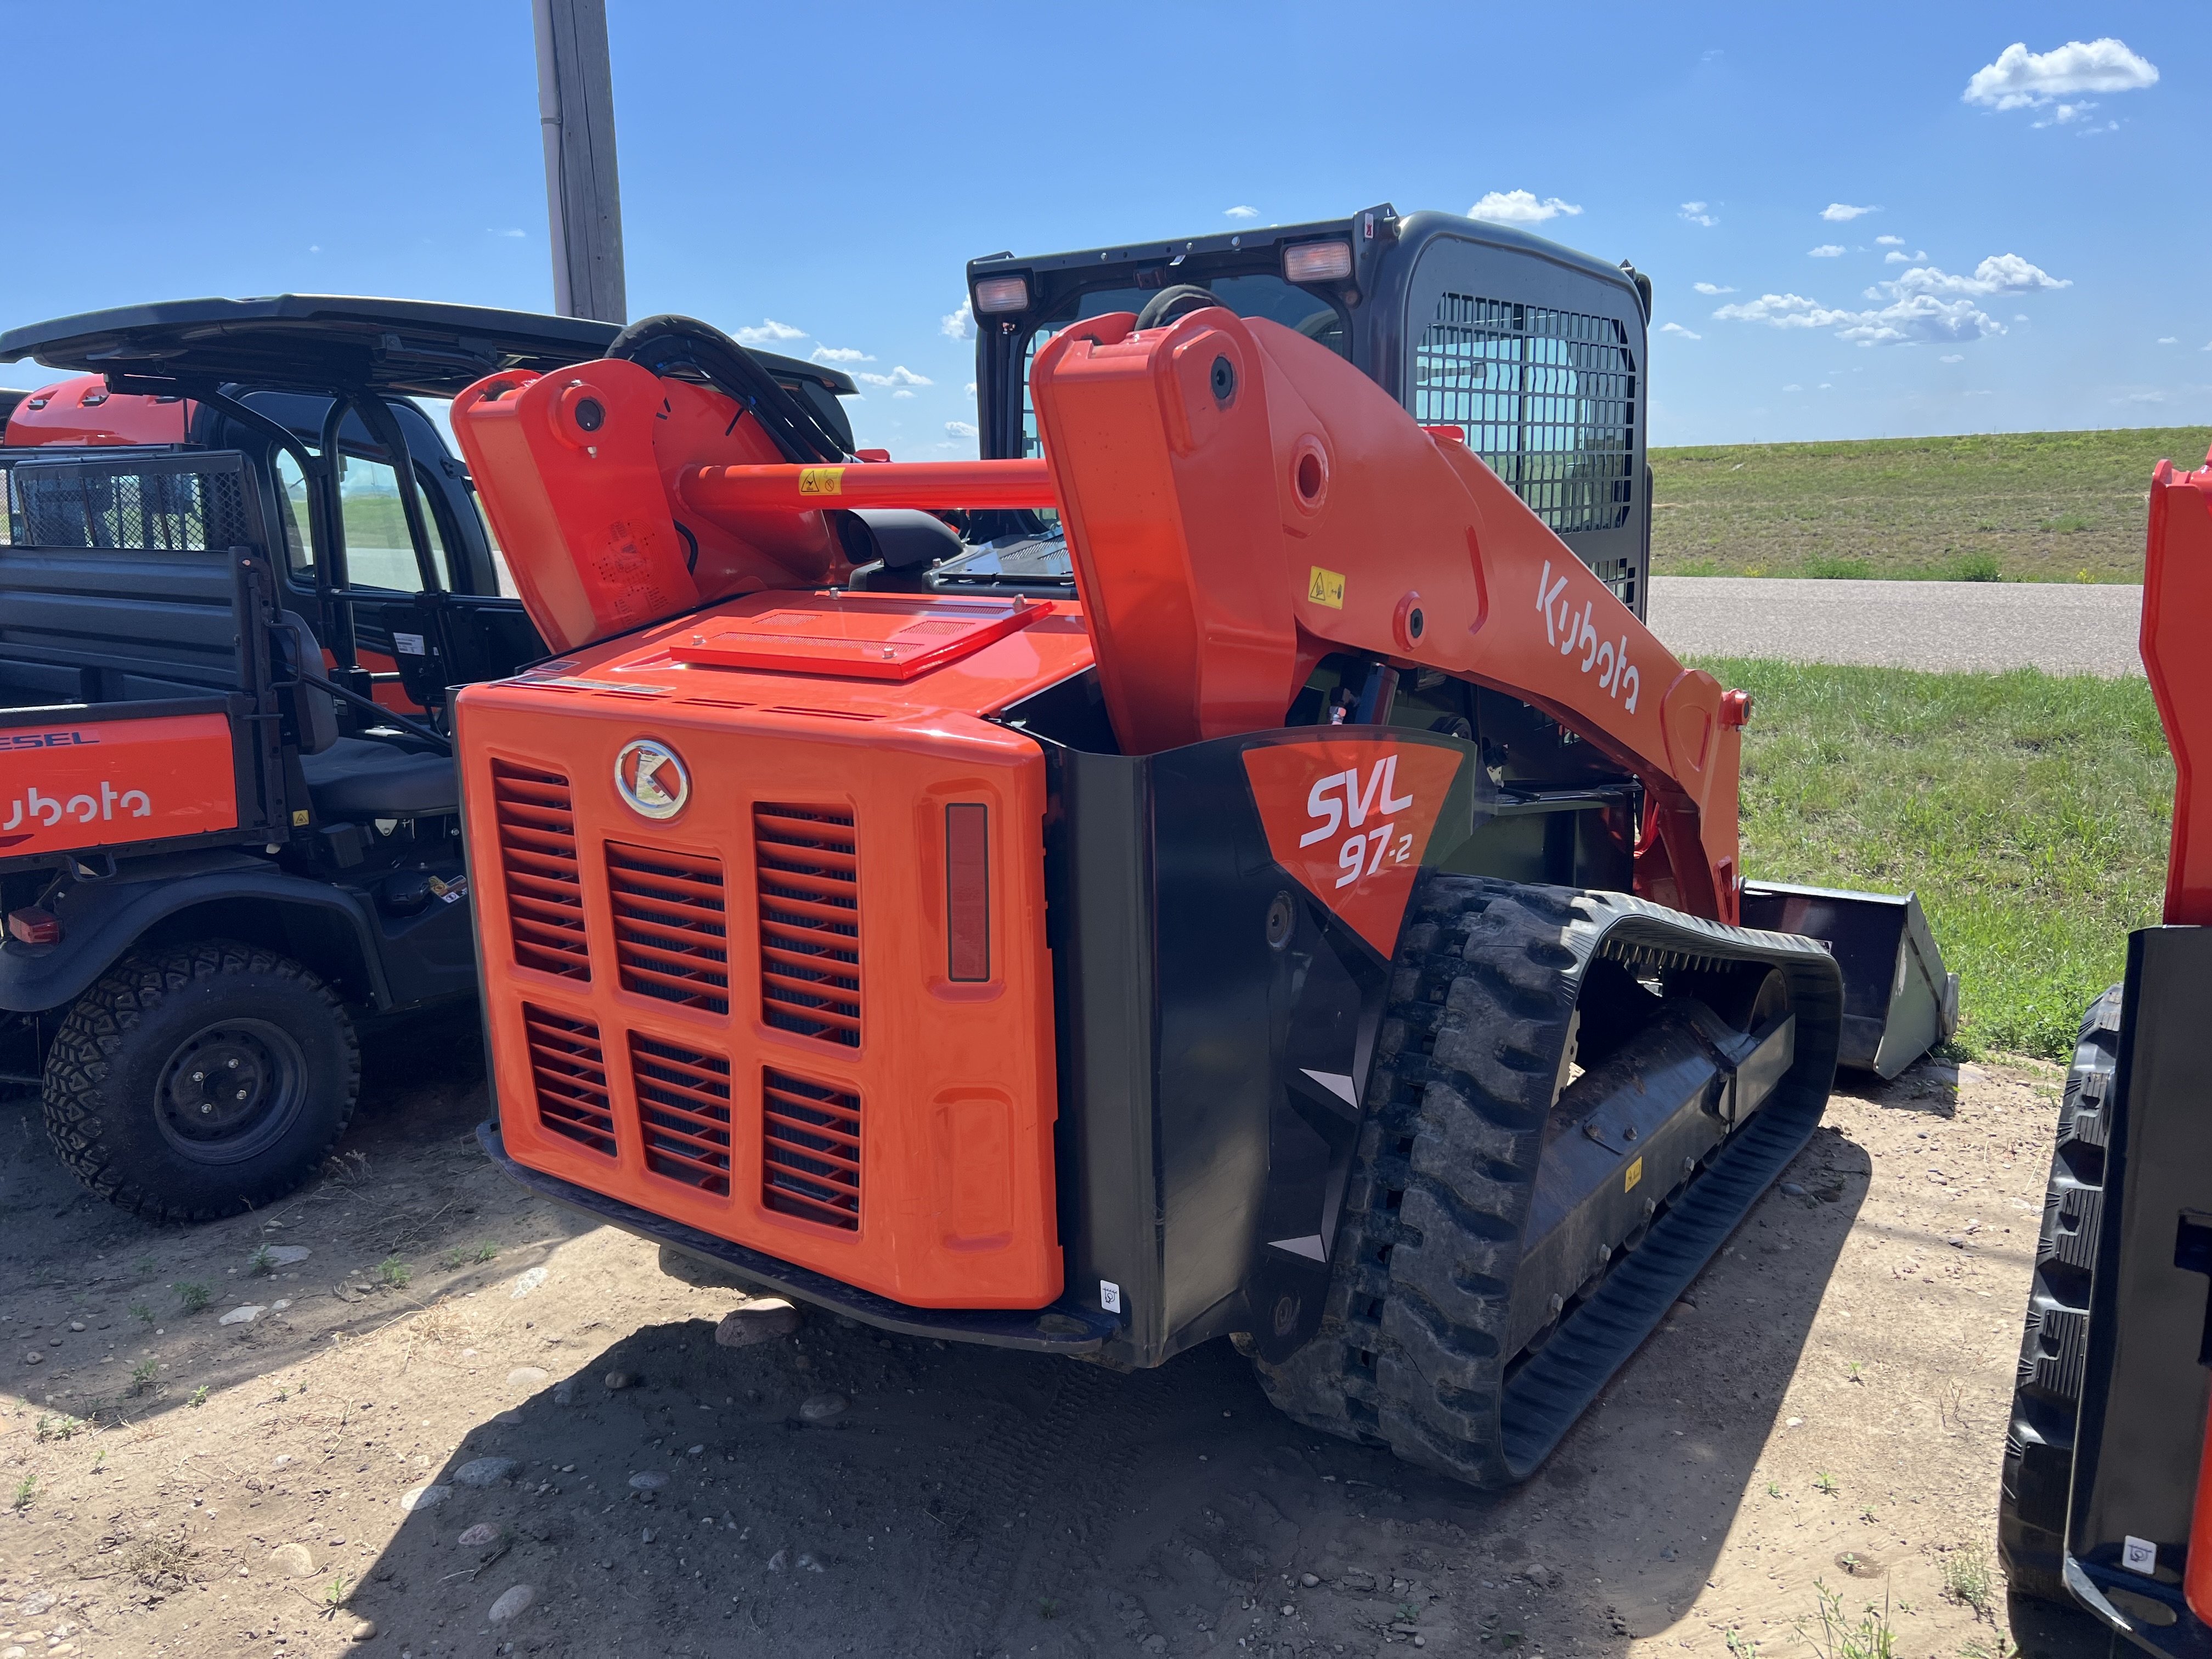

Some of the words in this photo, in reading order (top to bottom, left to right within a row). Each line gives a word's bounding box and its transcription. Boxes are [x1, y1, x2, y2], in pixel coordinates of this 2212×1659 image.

[1536, 559, 1639, 715] Kubota
[1299, 754, 1413, 849] SVL
[1335, 822, 1413, 889] 97-2
